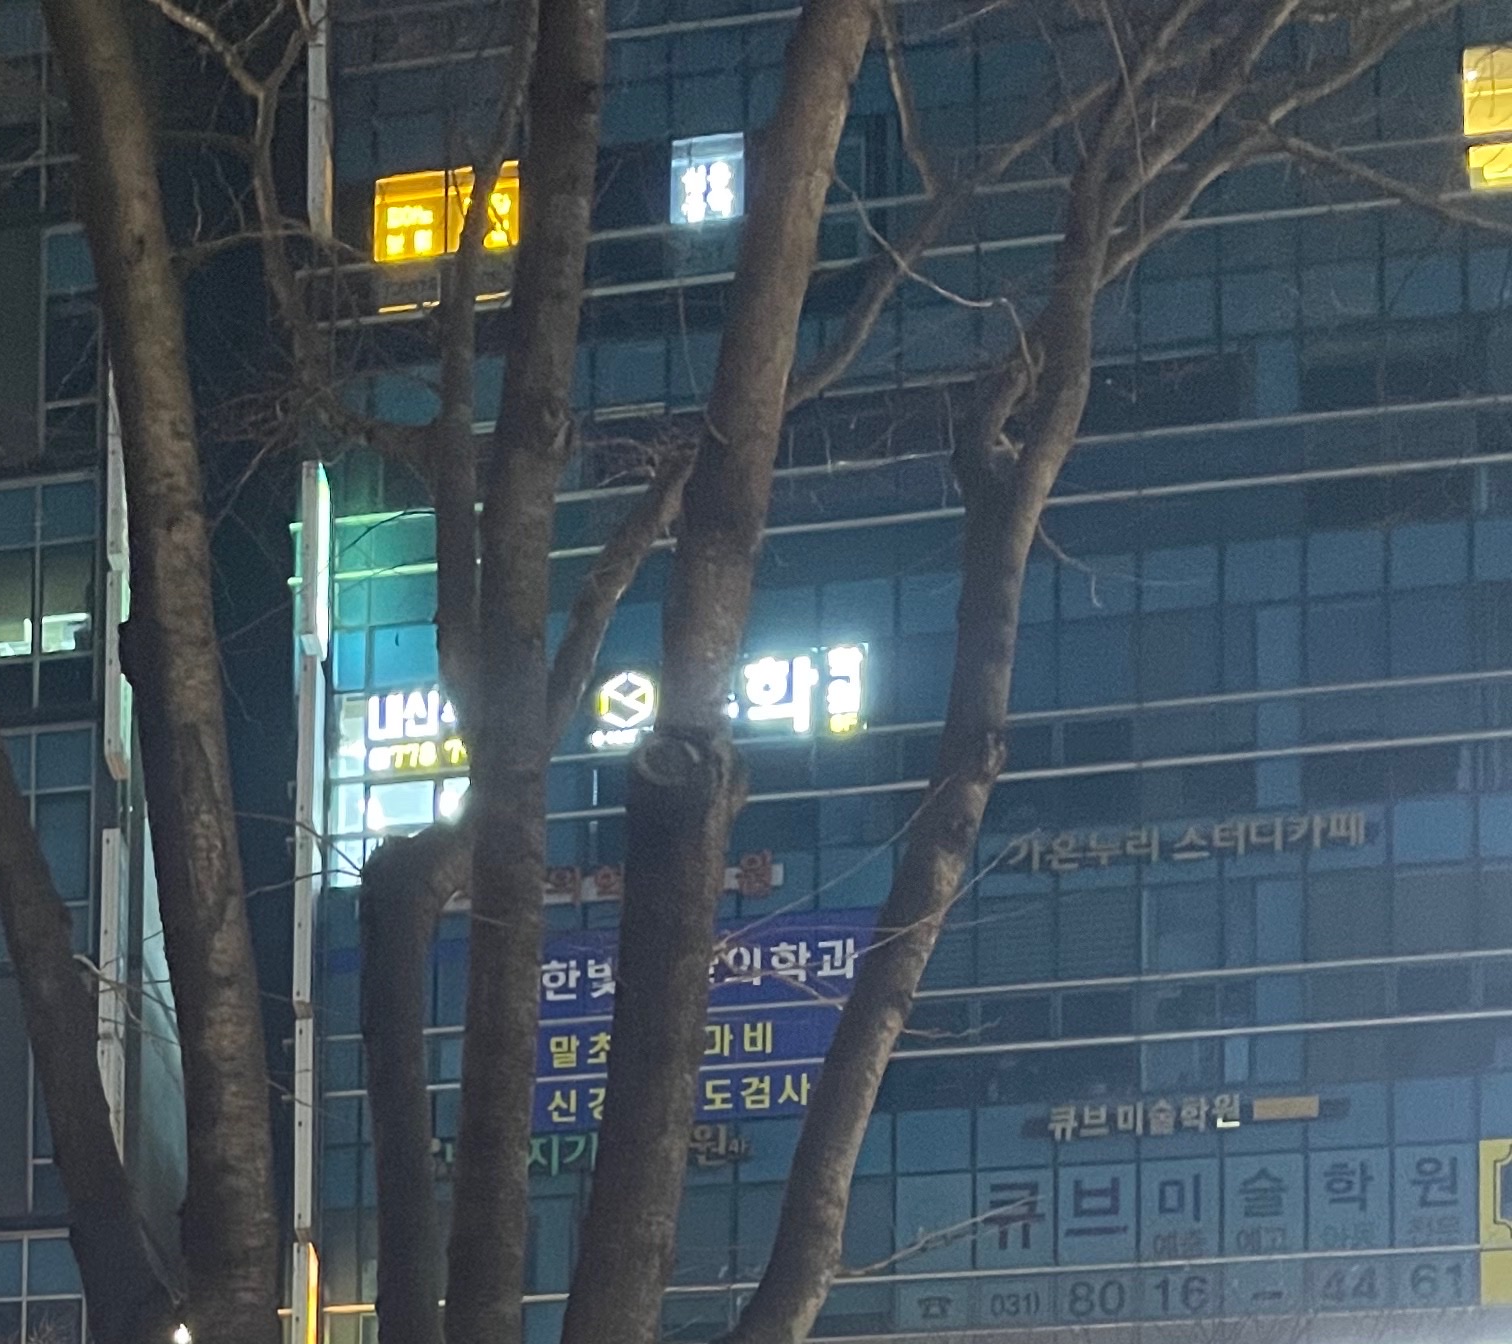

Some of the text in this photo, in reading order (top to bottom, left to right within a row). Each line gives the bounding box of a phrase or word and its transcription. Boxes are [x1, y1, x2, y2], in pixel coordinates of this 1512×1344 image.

[368, 687, 456, 741] 내신
[1007, 811, 1366, 872] 가온누리 스터디카페
[1048, 1093, 1241, 1142] 큐브미술학원
